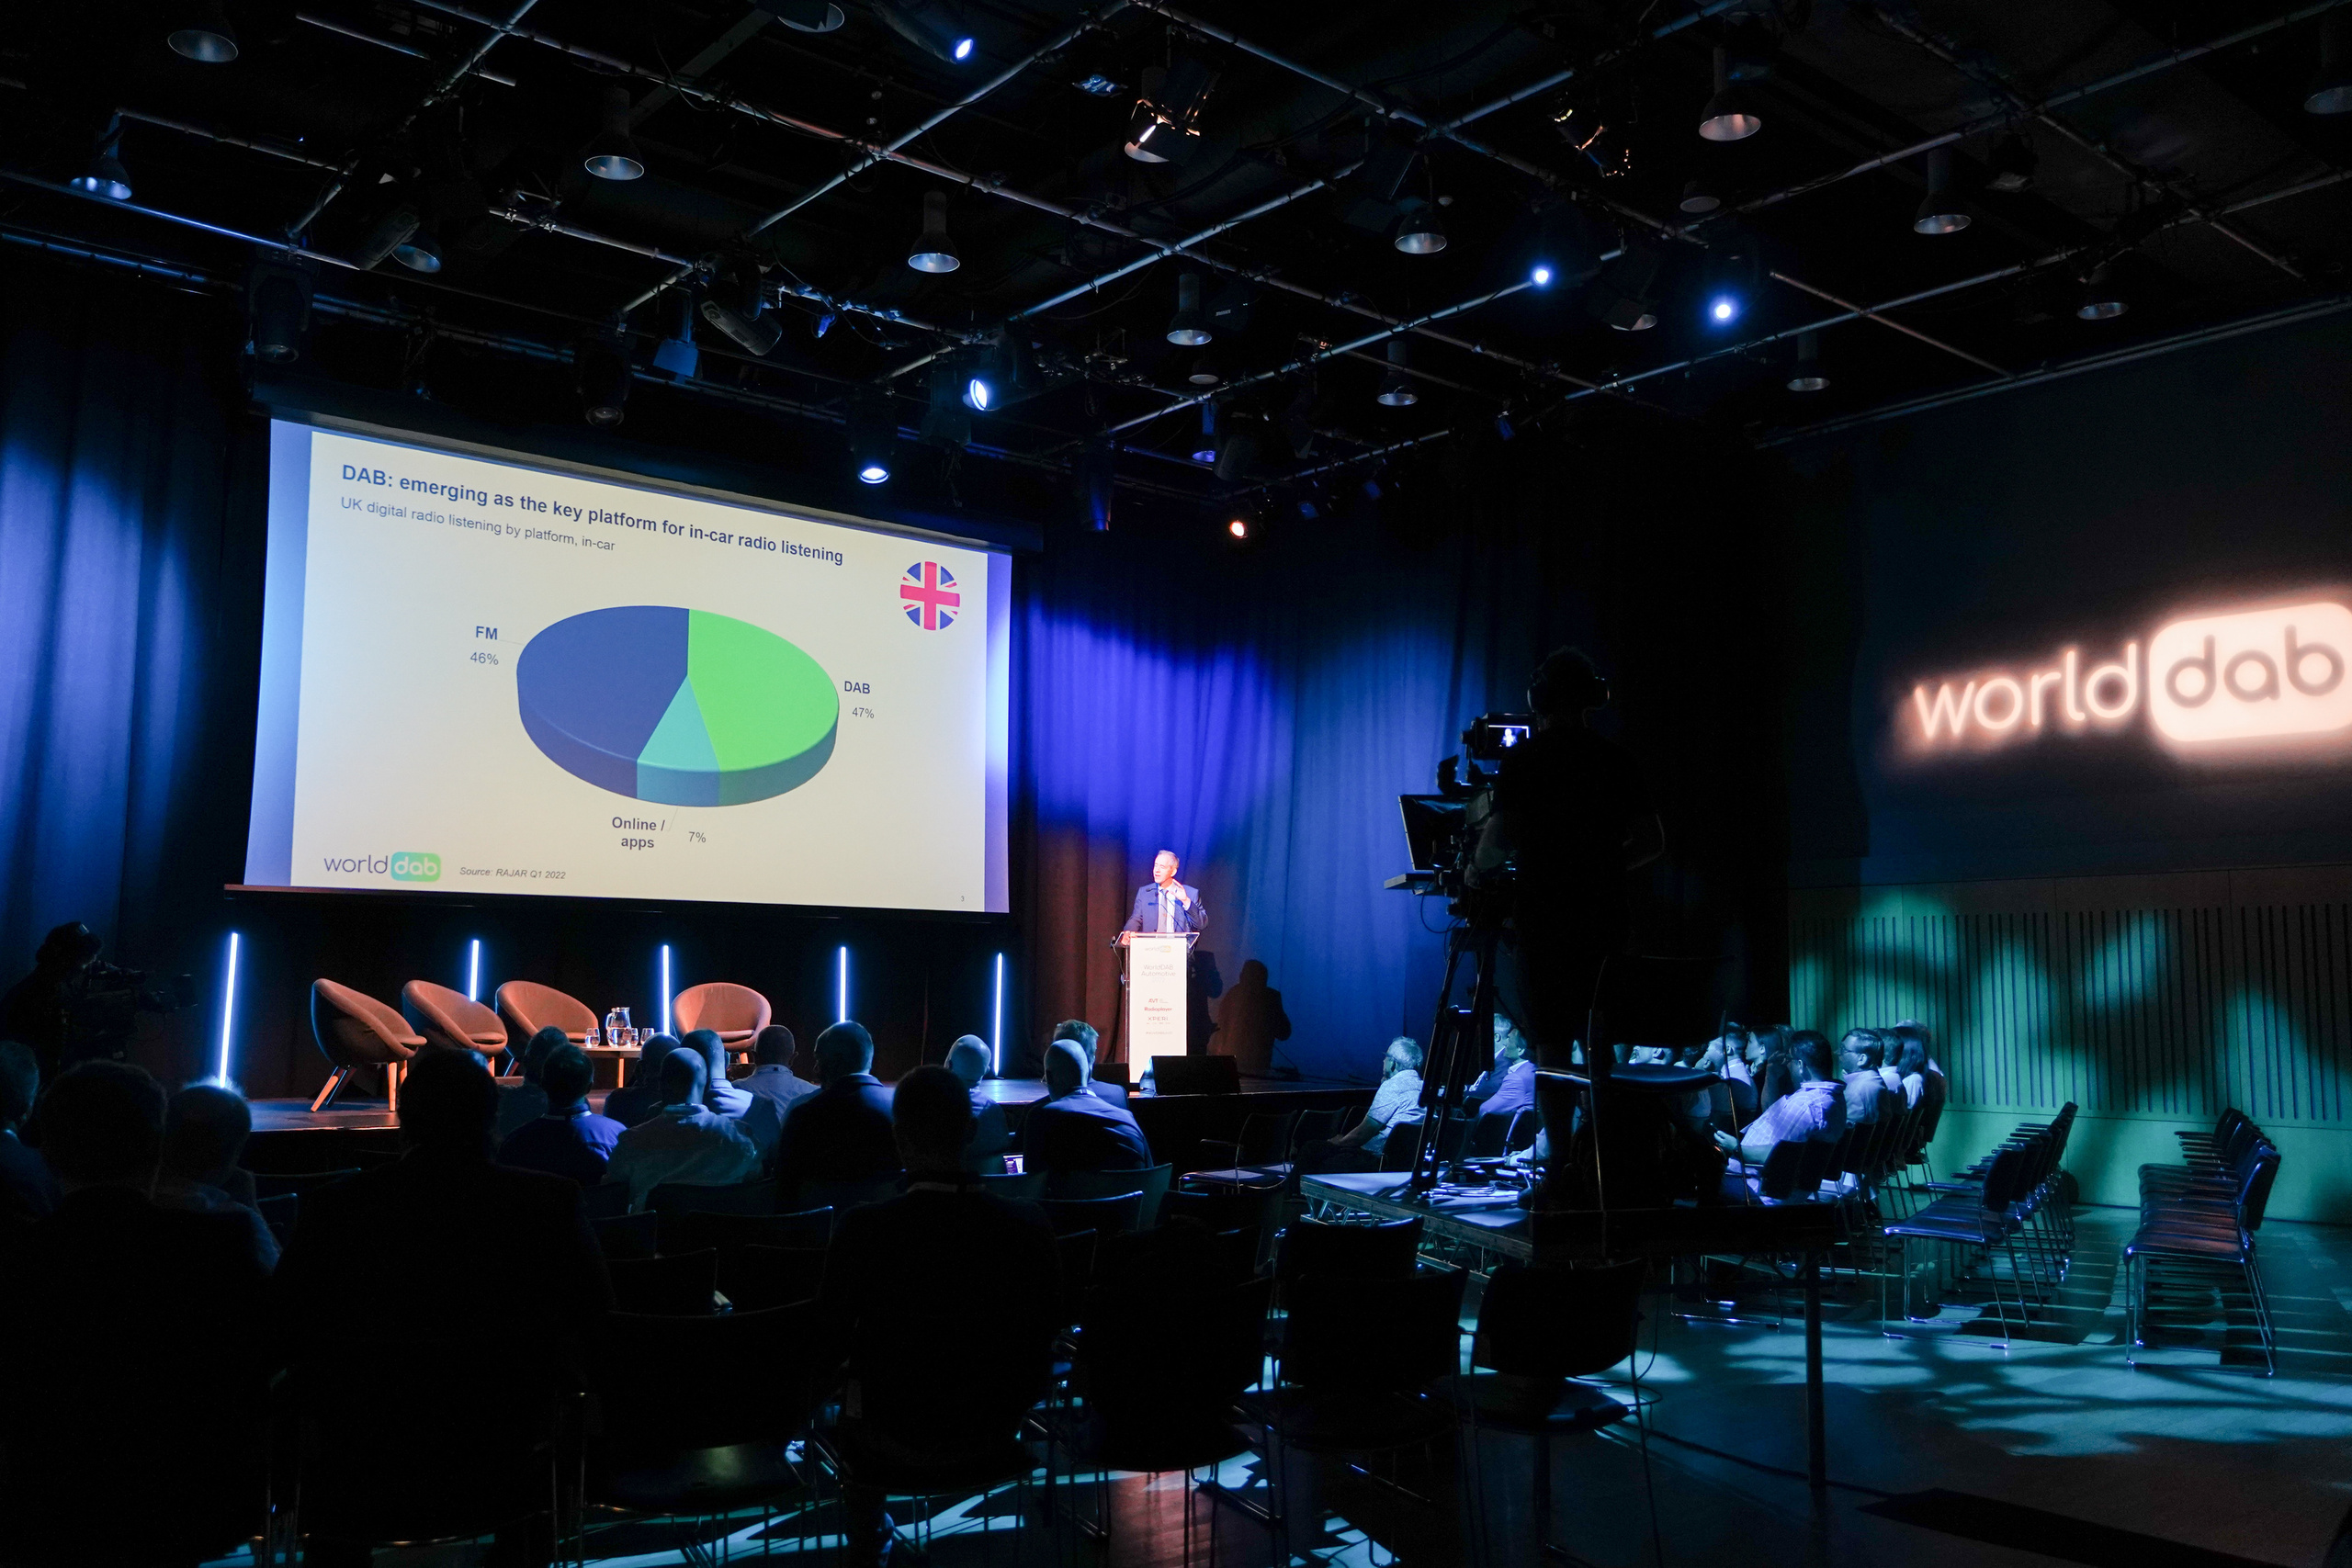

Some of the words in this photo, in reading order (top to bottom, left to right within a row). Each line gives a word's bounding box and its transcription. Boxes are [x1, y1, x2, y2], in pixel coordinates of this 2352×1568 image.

[342, 464, 393, 488] DAB:
[400, 477, 488, 506] emerging
[493, 492, 514, 507] as
[520, 495, 548, 513] the
[553, 501, 583, 522] key
[588, 508, 657, 532] platform
[662, 519, 685, 536] for
[689, 524, 734, 545] in-car
[738, 533, 776, 552] radio
[781, 540, 843, 566] listening
[341, 496, 363, 511] UK
[367, 502, 407, 518] digital
[412, 510, 445, 525] radio
[448, 513, 502, 536] listening
[505, 523, 522, 538] by
[525, 526, 578, 547] platform,
[582, 536, 616, 551] in-car
[475, 626, 499, 641] FM
[469, 651, 500, 666] 46%
[843, 680, 871, 694] DAB
[1914, 641, 2138, 739] world
[2165, 623, 2345, 709] dab
[851, 705, 875, 719] 47%
[611, 816, 657, 831] Online
[688, 830, 707, 843] 7%
[620, 837, 655, 852] apps
[323, 854, 389, 874] world
[394, 856, 438, 876] dab
[459, 866, 492, 876] Source:
[495, 868, 527, 878] RAJAR
[529, 869, 542, 879] Q1
[545, 871, 567, 880] 2022
